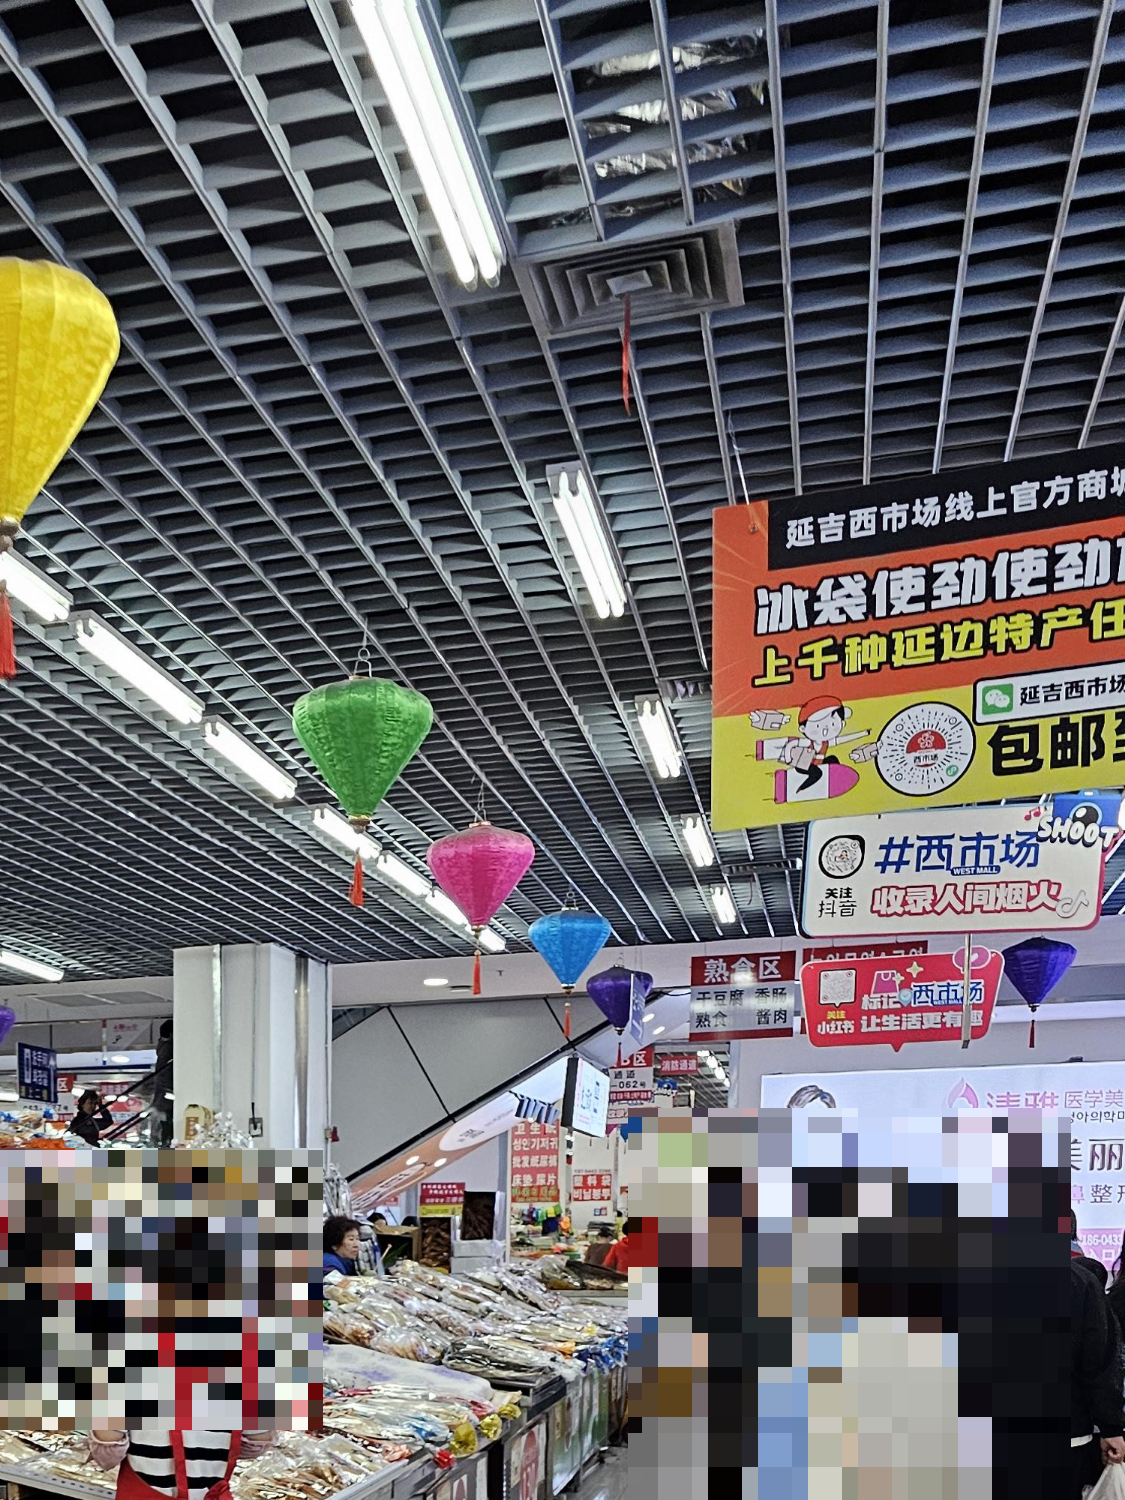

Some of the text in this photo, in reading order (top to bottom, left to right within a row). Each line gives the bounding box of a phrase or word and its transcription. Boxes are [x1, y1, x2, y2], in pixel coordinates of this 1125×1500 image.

[756, 535, 1125, 635] 冰袋使劲使劲
[988, 714, 1125, 776] 包邮
[1036, 815, 1121, 852] SHOOT
[875, 831, 1040, 874] #西市场
[953, 866, 998, 875] WEST MALL
[824, 886, 853, 899] 关注
[870, 880, 1062, 918] 收录人间烟火
[818, 900, 857, 918] 抖音
[696, 987, 788, 1008] 干豆腐 香肠
[861, 994, 901, 1010] 标记
[695, 1009, 788, 1028] 熟食 酱肉
[826, 1010, 846, 1020] 关注
[817, 1021, 855, 1035] 小红书
[661, 1058, 697, 1071] 消防通道
